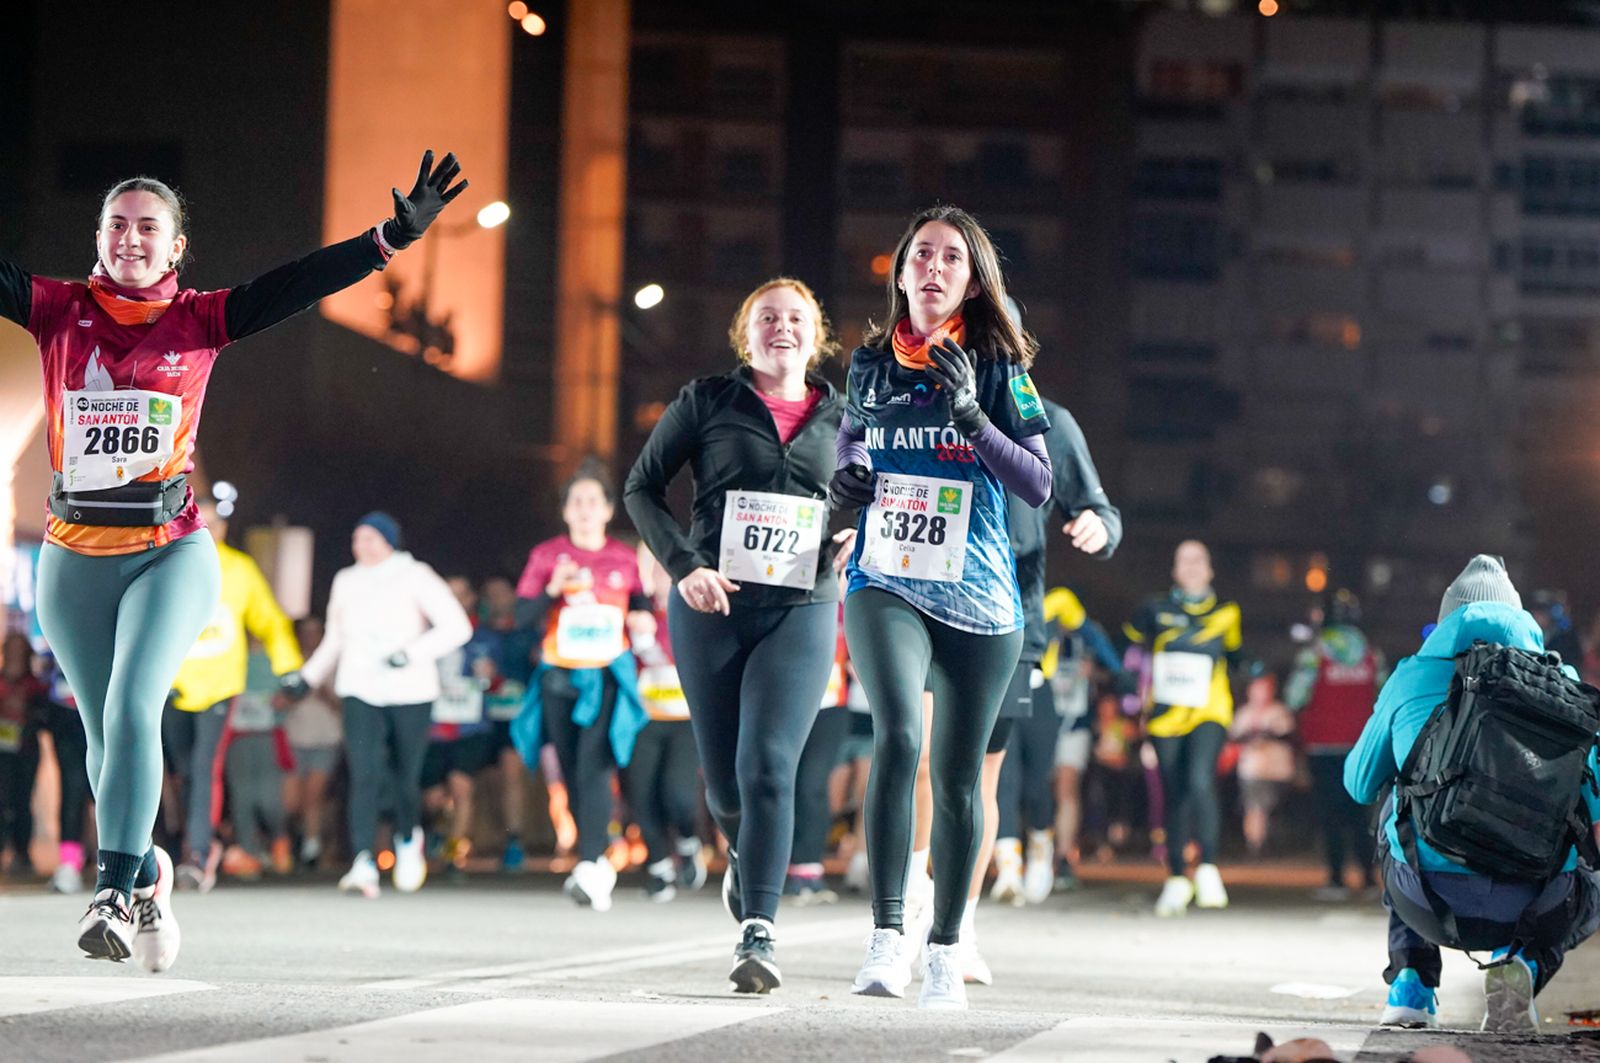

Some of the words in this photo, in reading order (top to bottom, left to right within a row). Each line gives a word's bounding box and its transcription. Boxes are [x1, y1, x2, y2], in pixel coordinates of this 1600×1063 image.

[91, 402, 124, 412] NOCHE
[126, 402, 139, 412] DE
[78, 414, 100, 425] SAN
[102, 412, 139, 425] ANTÓN
[84, 426, 160, 455] 2866
[865, 427, 885, 450] AN
[916, 488, 929, 498] DE
[749, 502, 776, 513] NOCHE
[736, 511, 756, 522] SAN
[880, 510, 947, 546] 5328
[743, 524, 800, 557] 6722
[899, 544, 916, 552] Celia
